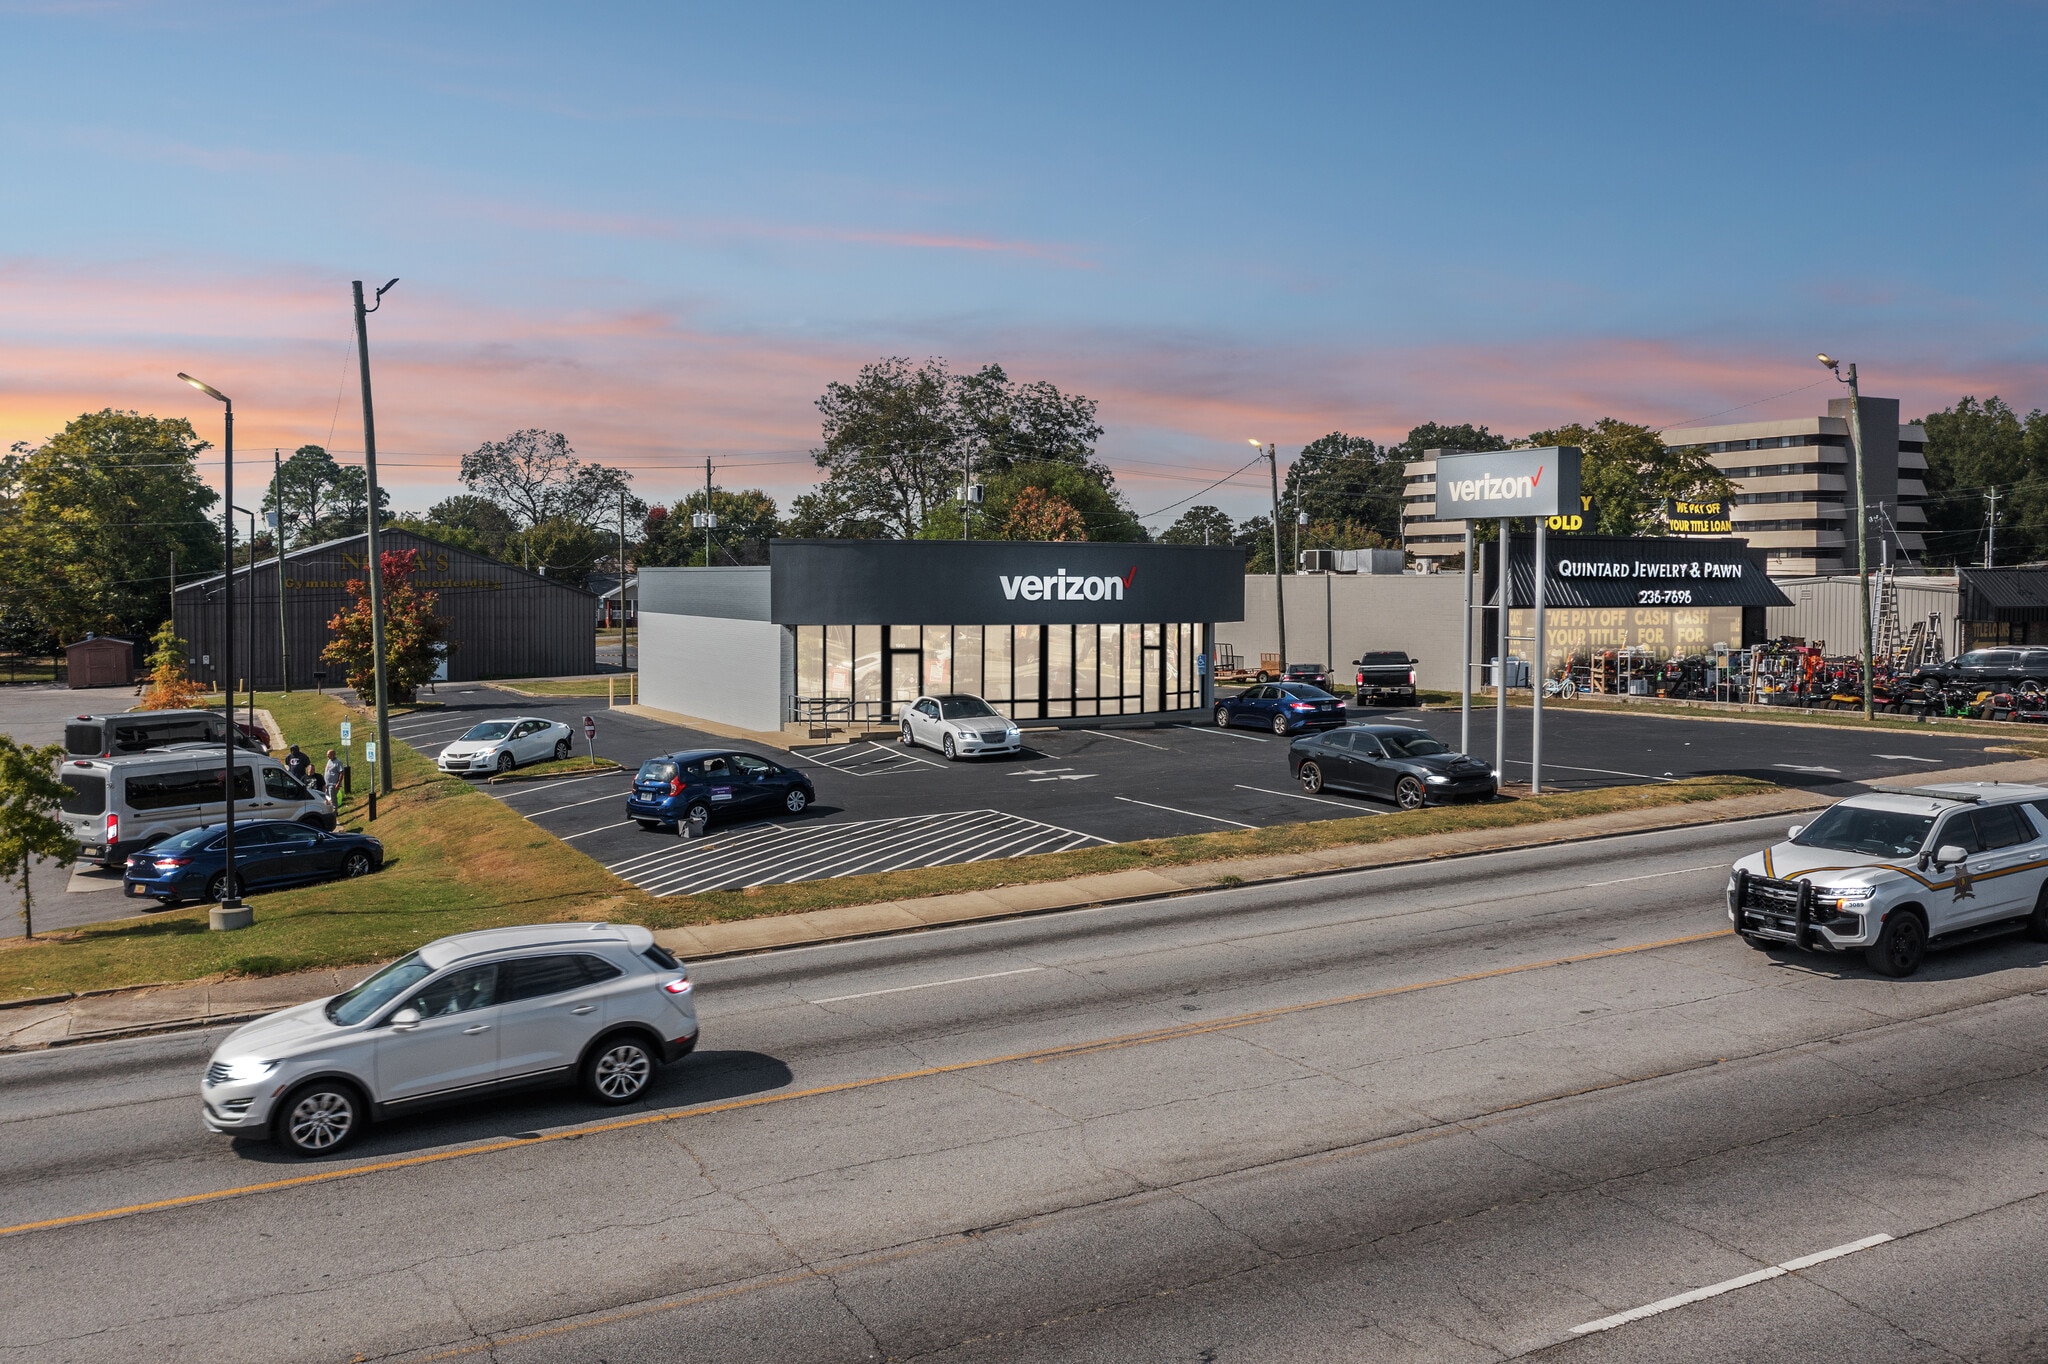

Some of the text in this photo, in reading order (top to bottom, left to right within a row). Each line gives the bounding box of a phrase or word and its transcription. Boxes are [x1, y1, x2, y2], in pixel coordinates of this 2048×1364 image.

[1448, 473, 1532, 501] verizon
[1676, 502, 1720, 514] WE PAY OFF
[1670, 520, 1732, 532] YOUR TITLE LOAN
[1559, 560, 1742, 578] QUINTARD JEWELRY & PAWN
[999, 568, 1124, 601] verizon
[1639, 590, 1692, 604] 236-7696
[1572, 610, 1598, 626] PAY
[1600, 610, 1627, 626] OFF
[1635, 609, 1669, 626] CASH
[1674, 609, 1709, 625] CASH
[1547, 628, 1626, 645] YOUR TITLE
[1637, 628, 1665, 643] FOR
[1677, 628, 1705, 642] FOR
